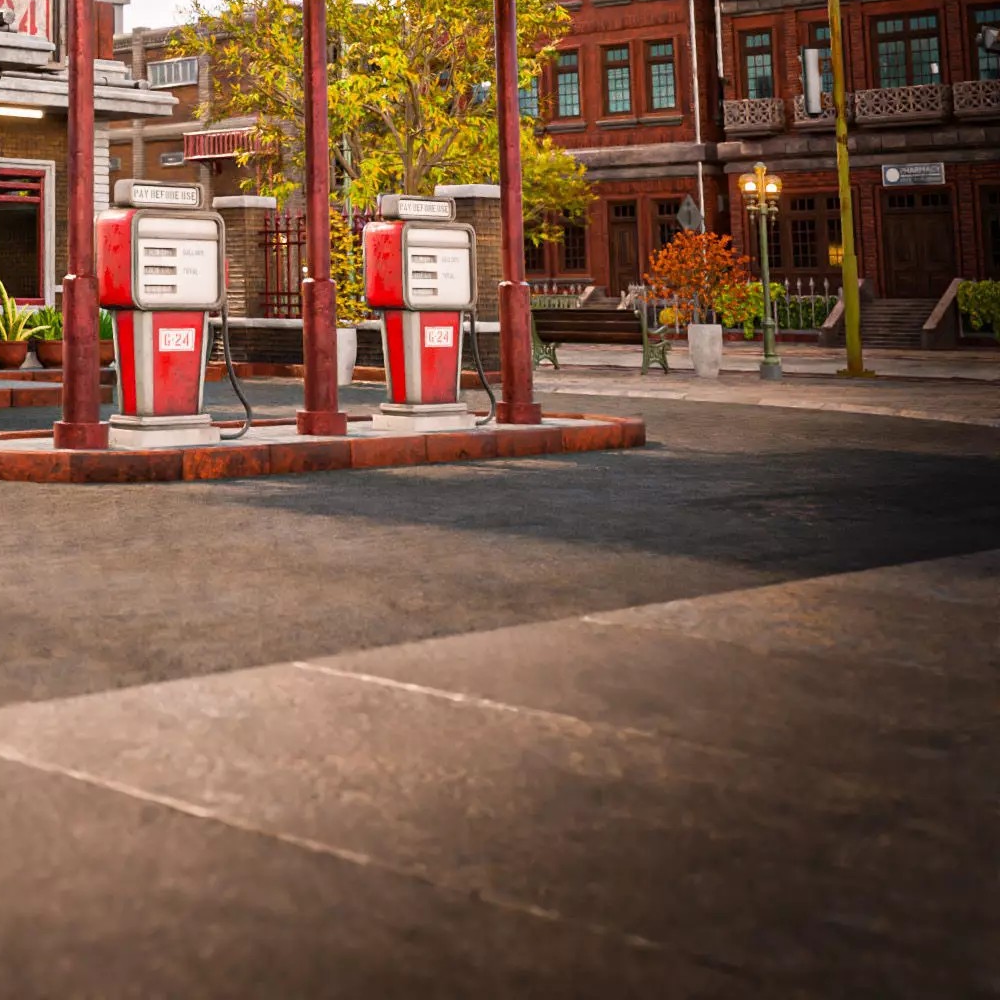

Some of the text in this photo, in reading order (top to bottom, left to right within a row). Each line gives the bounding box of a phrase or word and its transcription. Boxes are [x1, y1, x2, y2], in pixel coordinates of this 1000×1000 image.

[134, 188, 196, 201] PAY BEFORE USE
[400, 202, 412, 212] PAY
